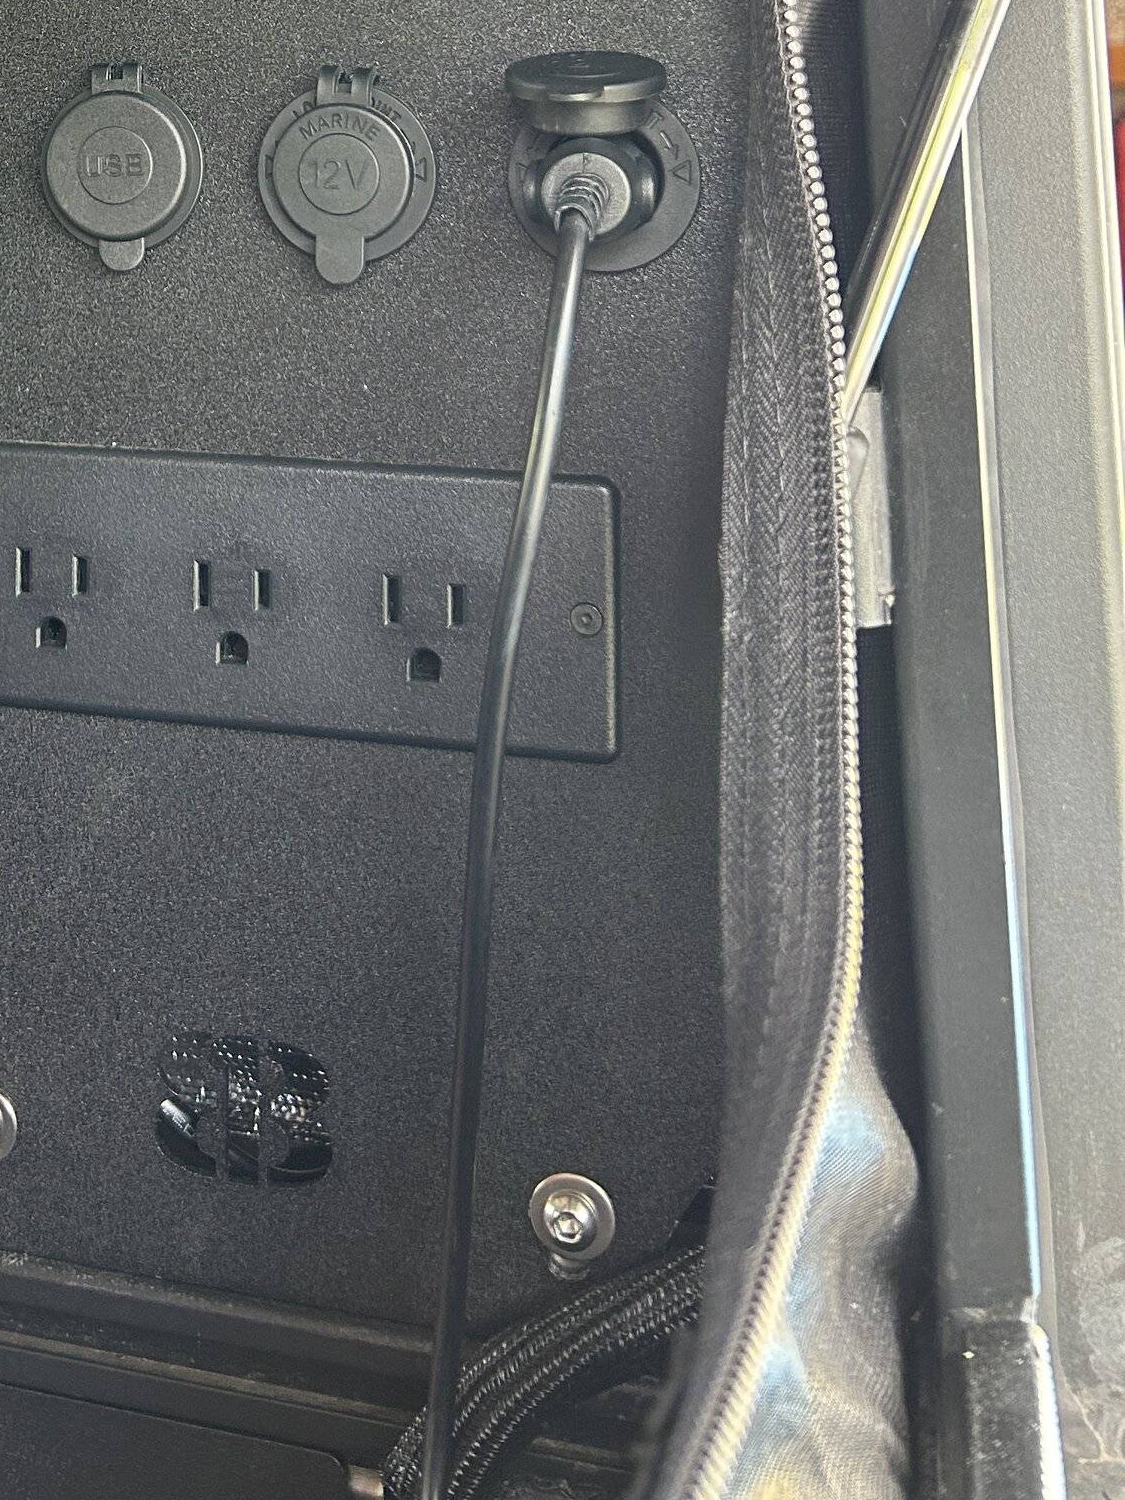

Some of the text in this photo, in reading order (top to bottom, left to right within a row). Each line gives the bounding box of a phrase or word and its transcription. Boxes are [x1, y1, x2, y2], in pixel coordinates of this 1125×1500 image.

[299, 112, 382, 142] MARINE
[84, 153, 145, 177] USB
[307, 159, 368, 190] 12V
